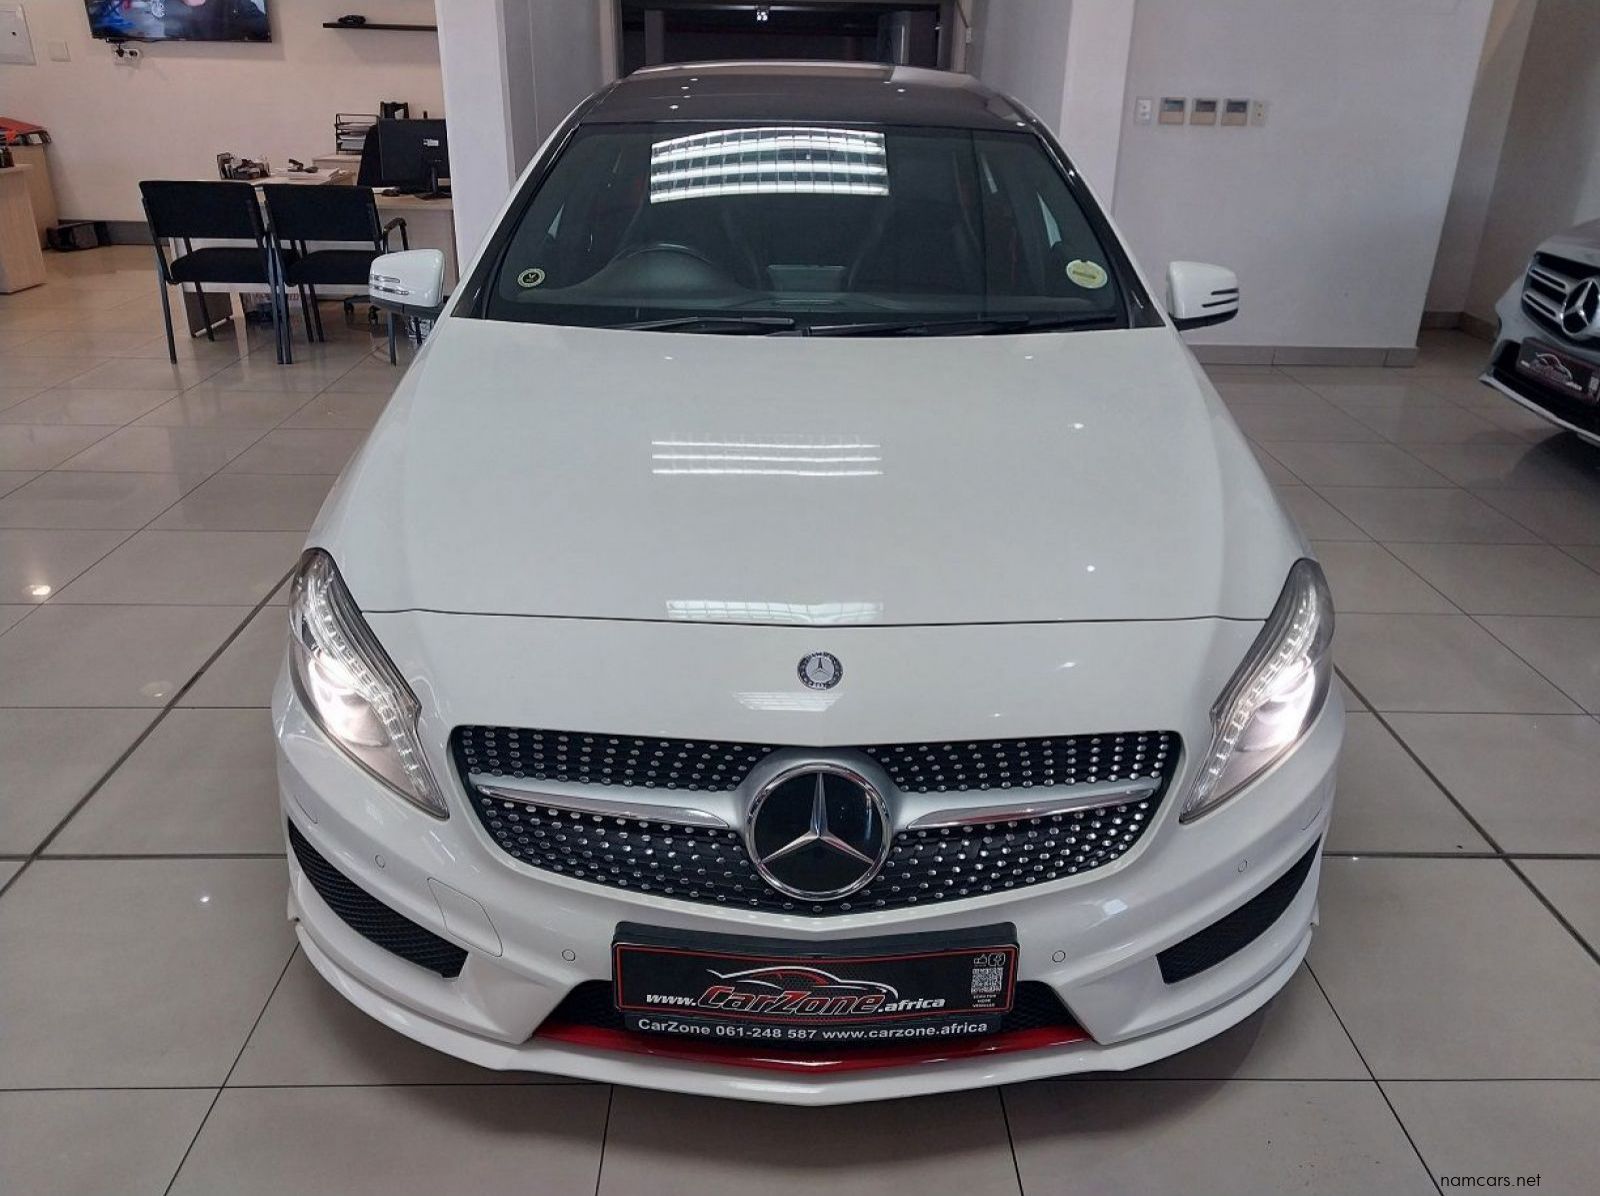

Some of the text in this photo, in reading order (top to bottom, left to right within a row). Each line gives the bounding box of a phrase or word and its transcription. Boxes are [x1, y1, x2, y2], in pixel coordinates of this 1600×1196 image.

[638, 1016, 988, 1039] CarZone 061-248 587 www.carzone.africa
